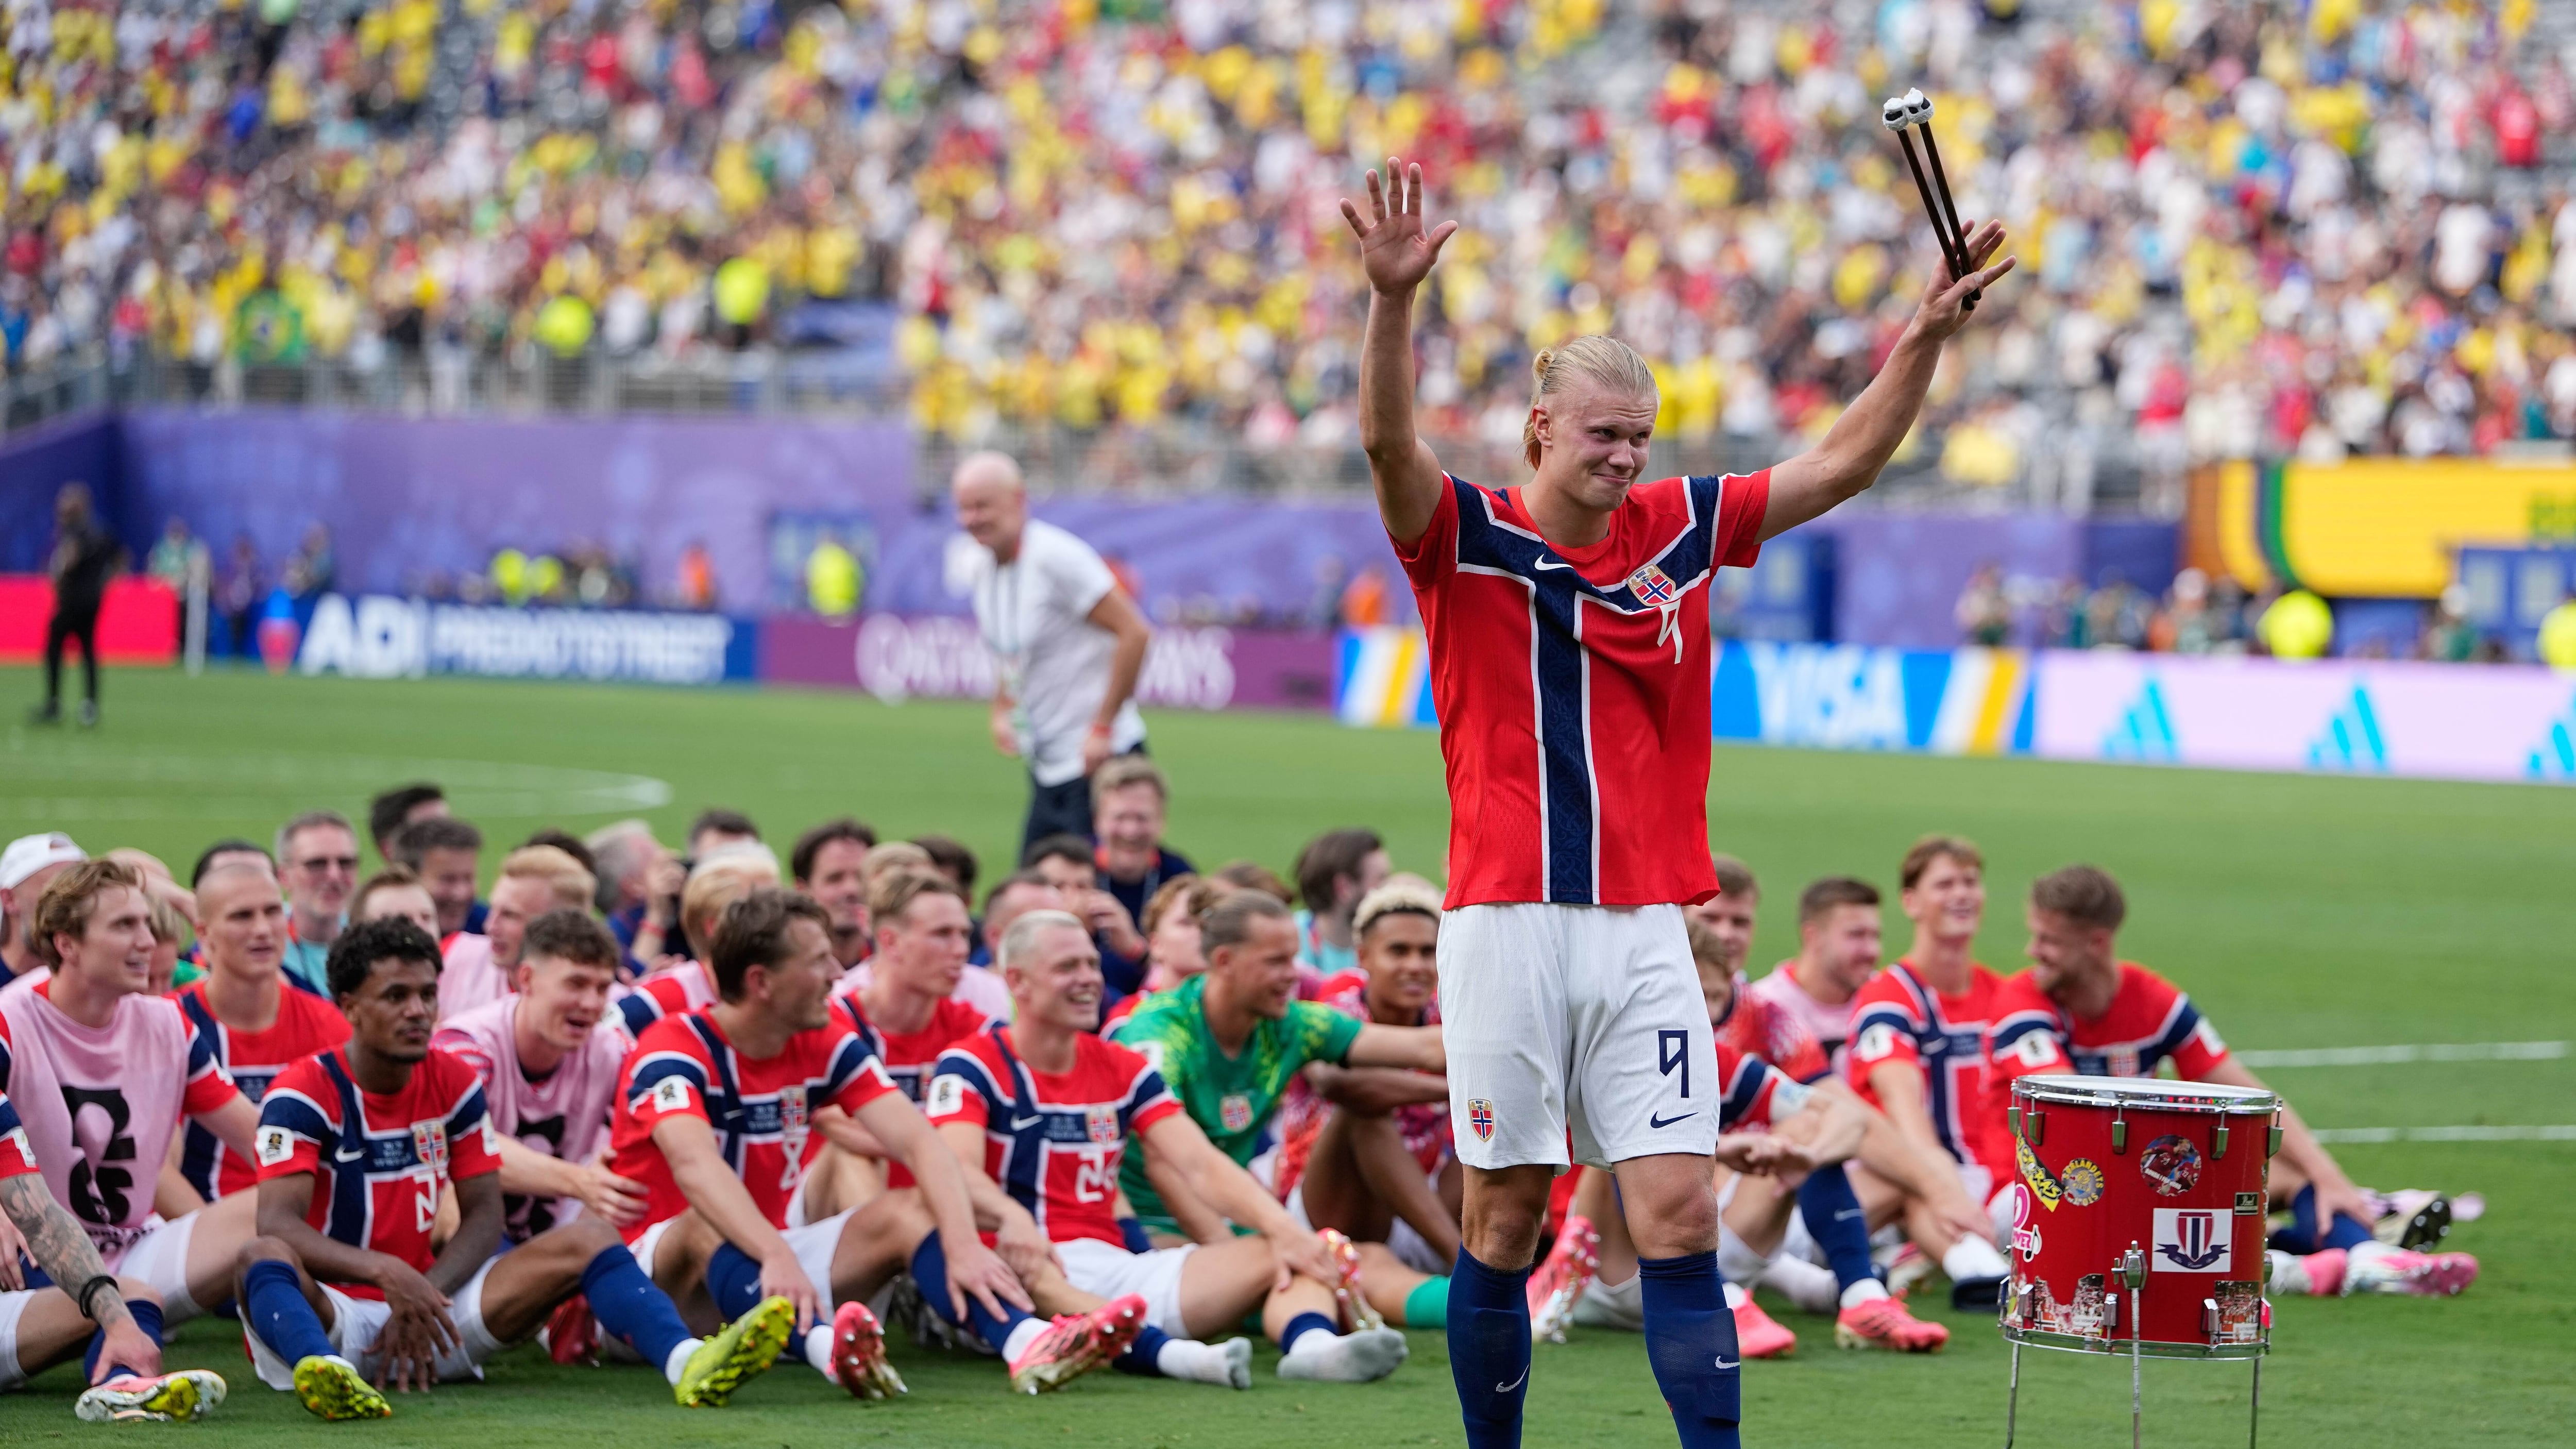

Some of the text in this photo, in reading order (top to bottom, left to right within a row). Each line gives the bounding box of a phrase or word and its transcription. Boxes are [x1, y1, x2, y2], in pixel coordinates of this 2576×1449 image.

[1635, 570, 1647, 579] NORGE
[1657, 598, 1683, 664] 9
[1754, 641, 1907, 750] VISA
[1658, 1030, 1689, 1098] 9
